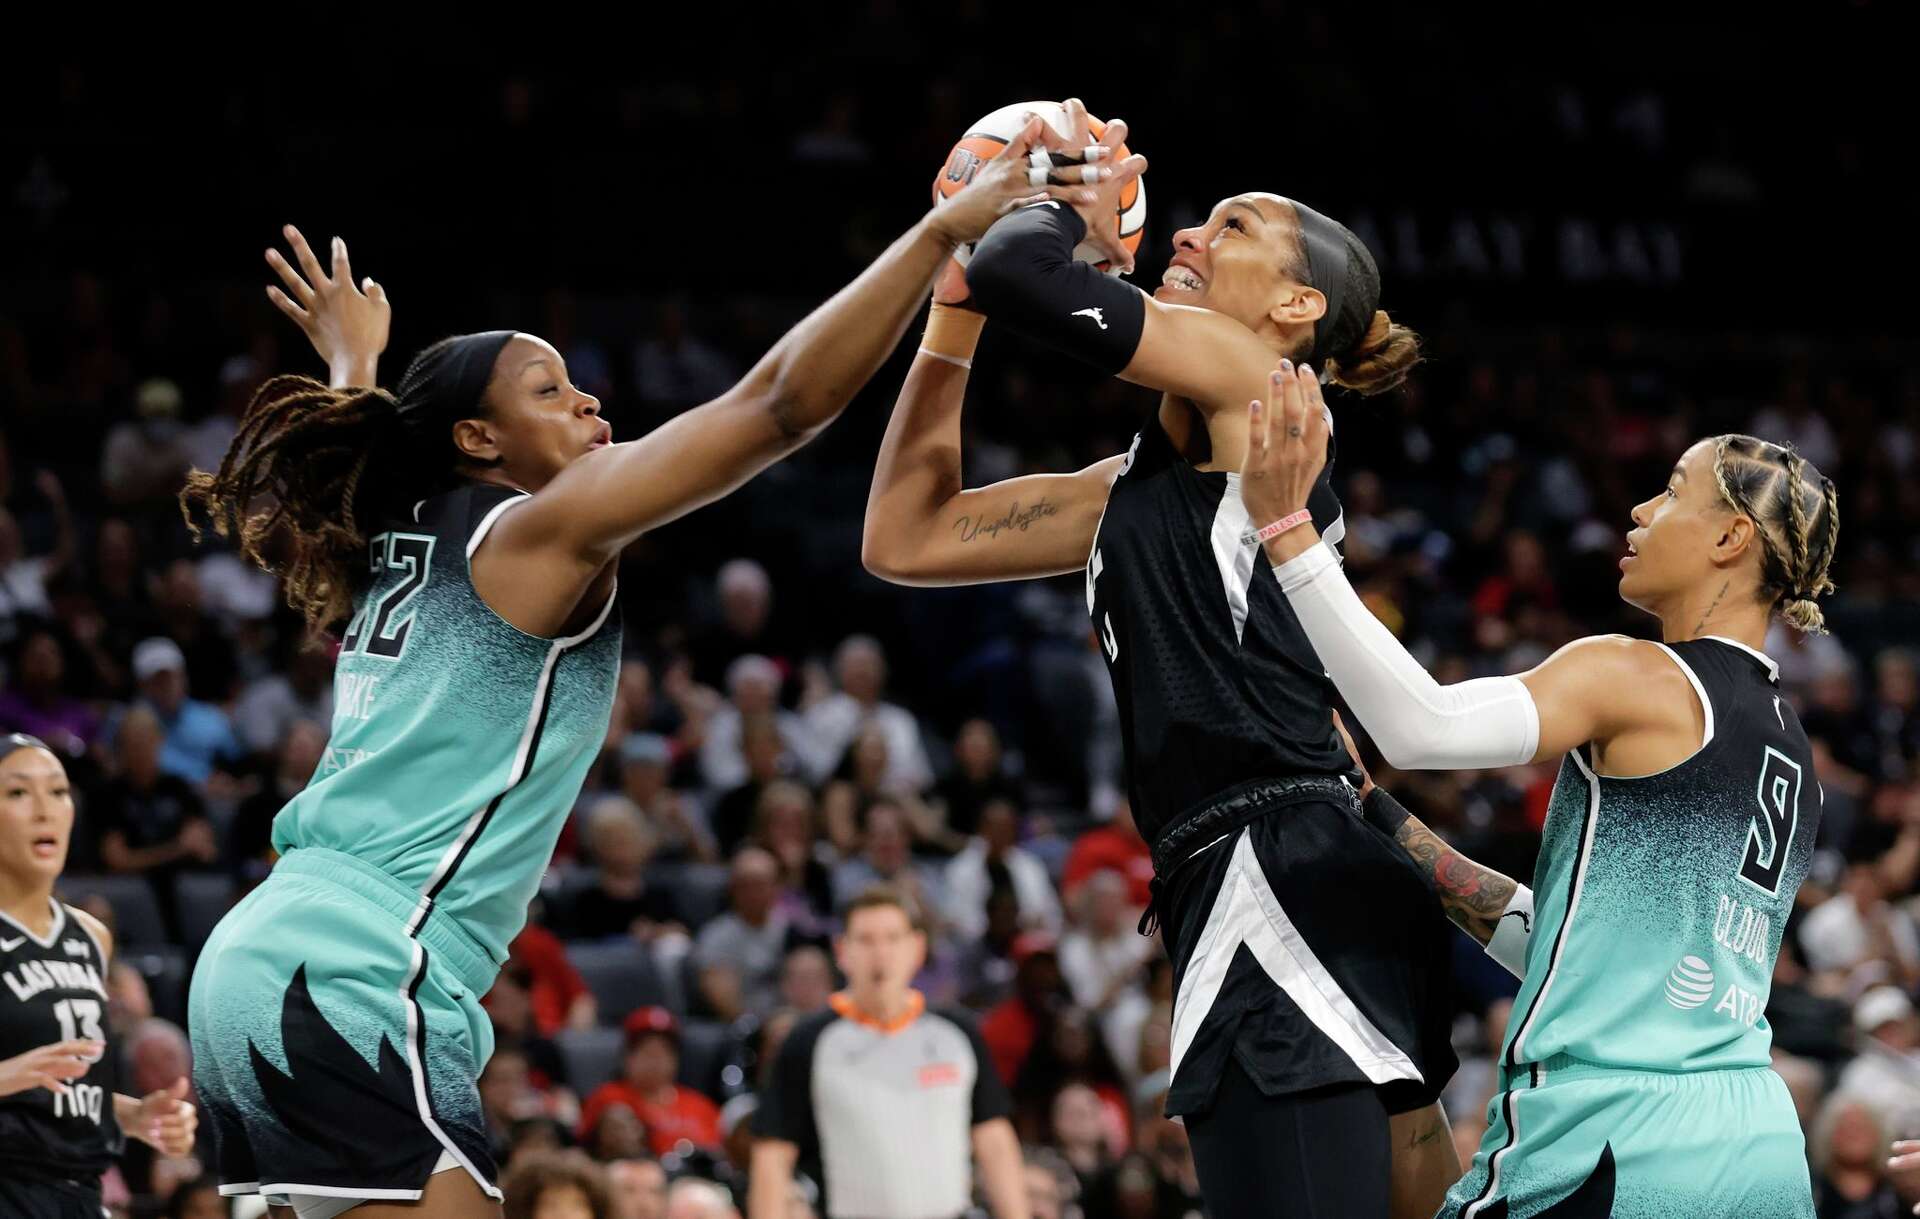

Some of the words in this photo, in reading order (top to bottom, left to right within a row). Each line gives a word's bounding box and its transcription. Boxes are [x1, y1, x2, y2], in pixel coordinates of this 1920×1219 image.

[1258, 510, 1311, 540] PALESTIN
[1738, 744, 1801, 896] 9
[53, 998, 106, 1066] 13
